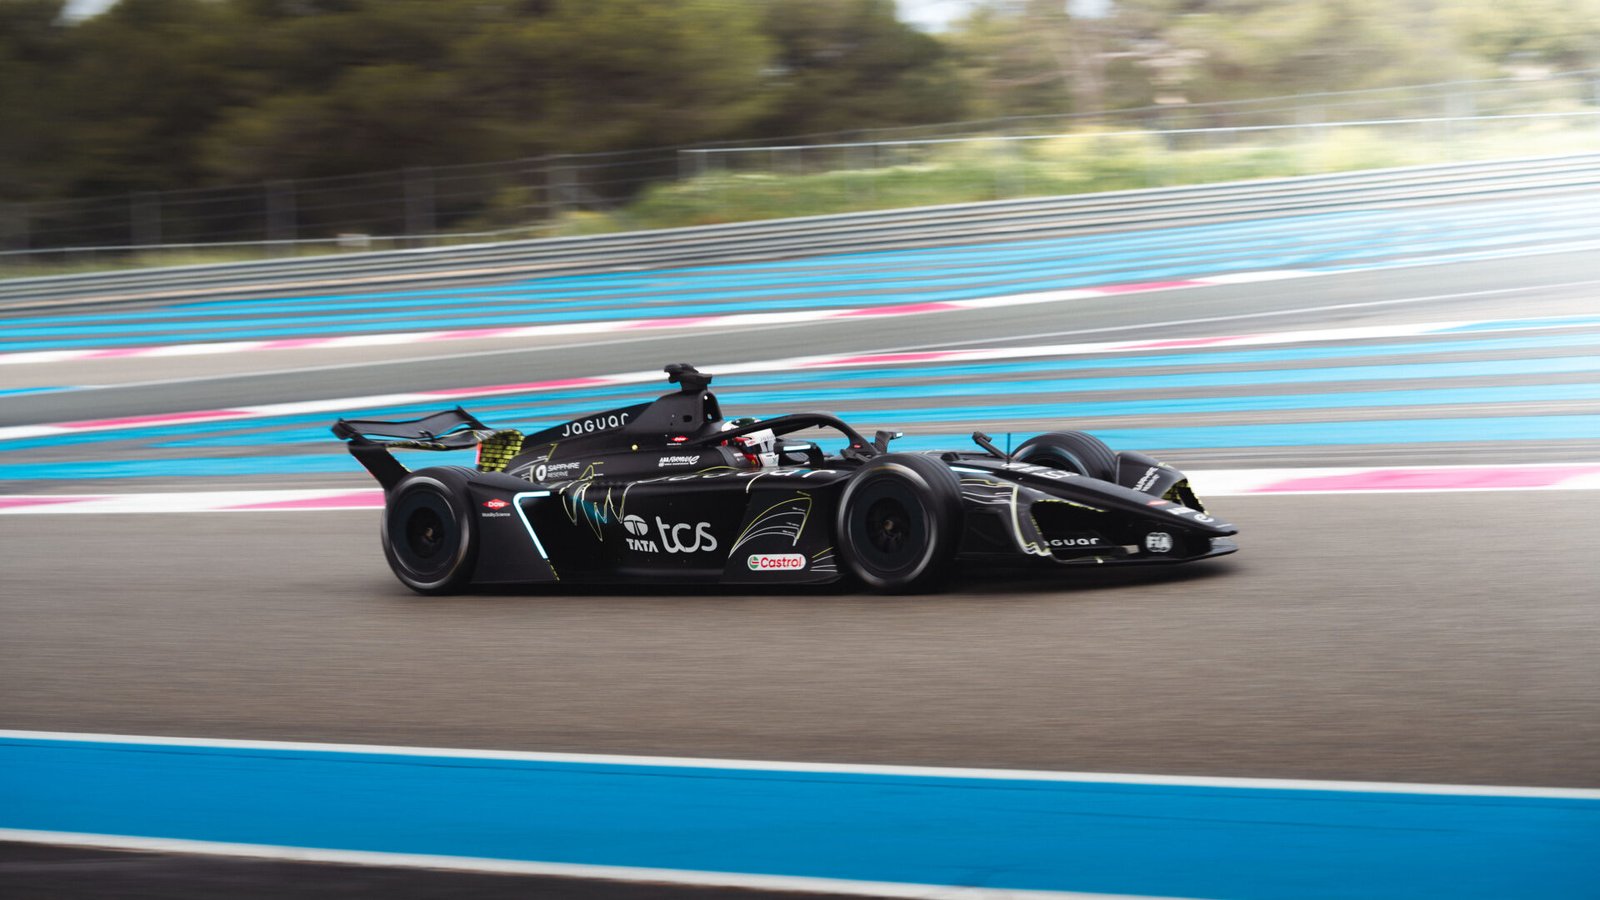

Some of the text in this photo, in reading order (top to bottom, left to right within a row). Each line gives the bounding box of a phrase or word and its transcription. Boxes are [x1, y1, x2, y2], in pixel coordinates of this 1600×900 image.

[625, 515, 718, 554] TATA tcs
[1146, 535, 1171, 549] FIA
[760, 556, 802, 568] Castrol
